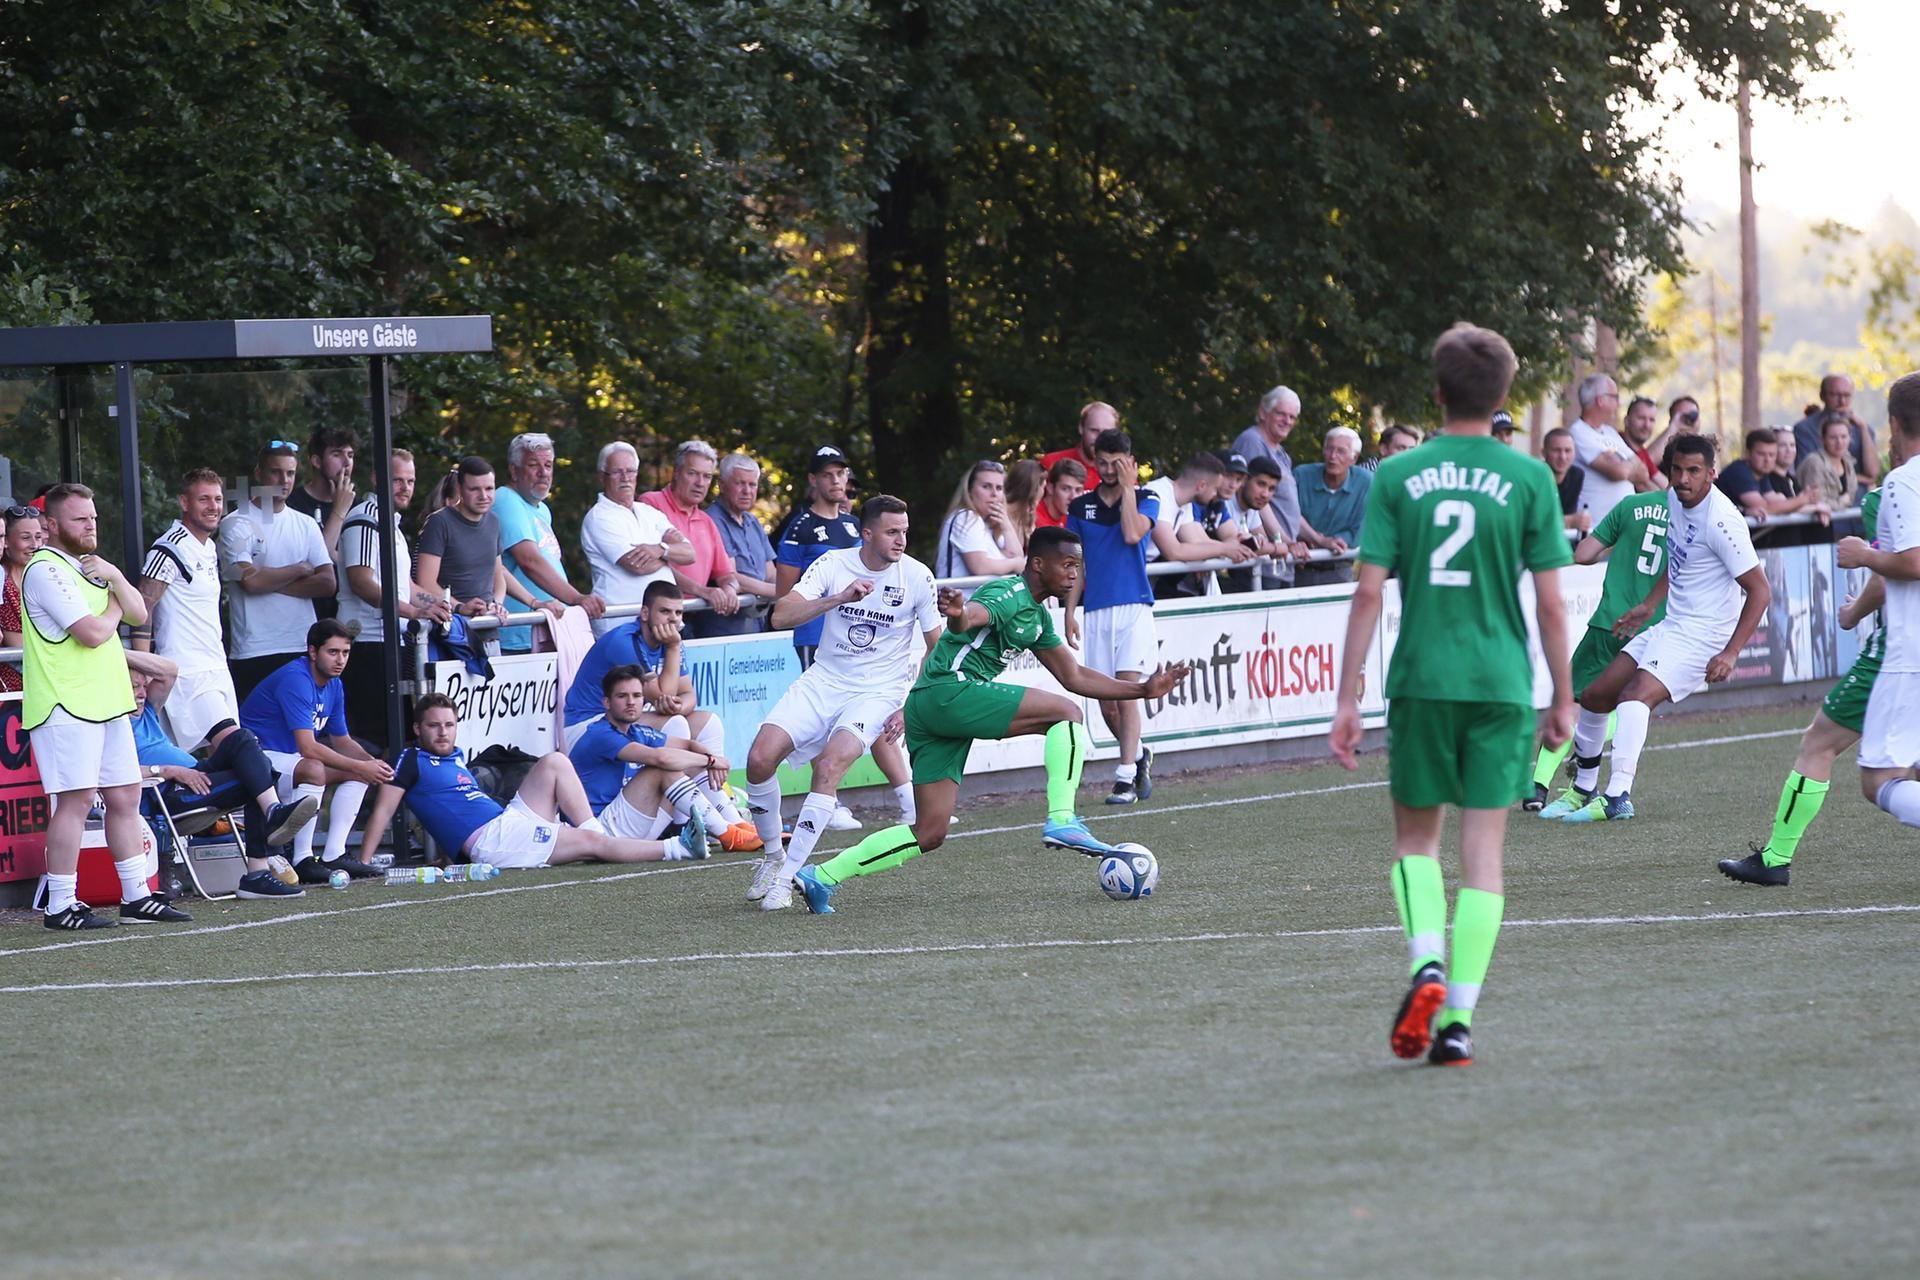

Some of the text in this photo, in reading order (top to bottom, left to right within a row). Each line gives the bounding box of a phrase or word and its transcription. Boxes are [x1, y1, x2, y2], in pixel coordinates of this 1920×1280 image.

[312, 322, 418, 348] Unsere Gäste
[1404, 461, 1513, 506] BRÖLTAL
[1633, 504, 1670, 522] BRÖL
[1429, 499, 1476, 586] 2
[1637, 523, 1666, 576] 5
[838, 605, 894, 623] PETER KAHM
[728, 653, 786, 675] Gemeindewerke
[1246, 631, 1335, 700] KÖLSCH
[728, 684, 768, 703] Nümbrecht
